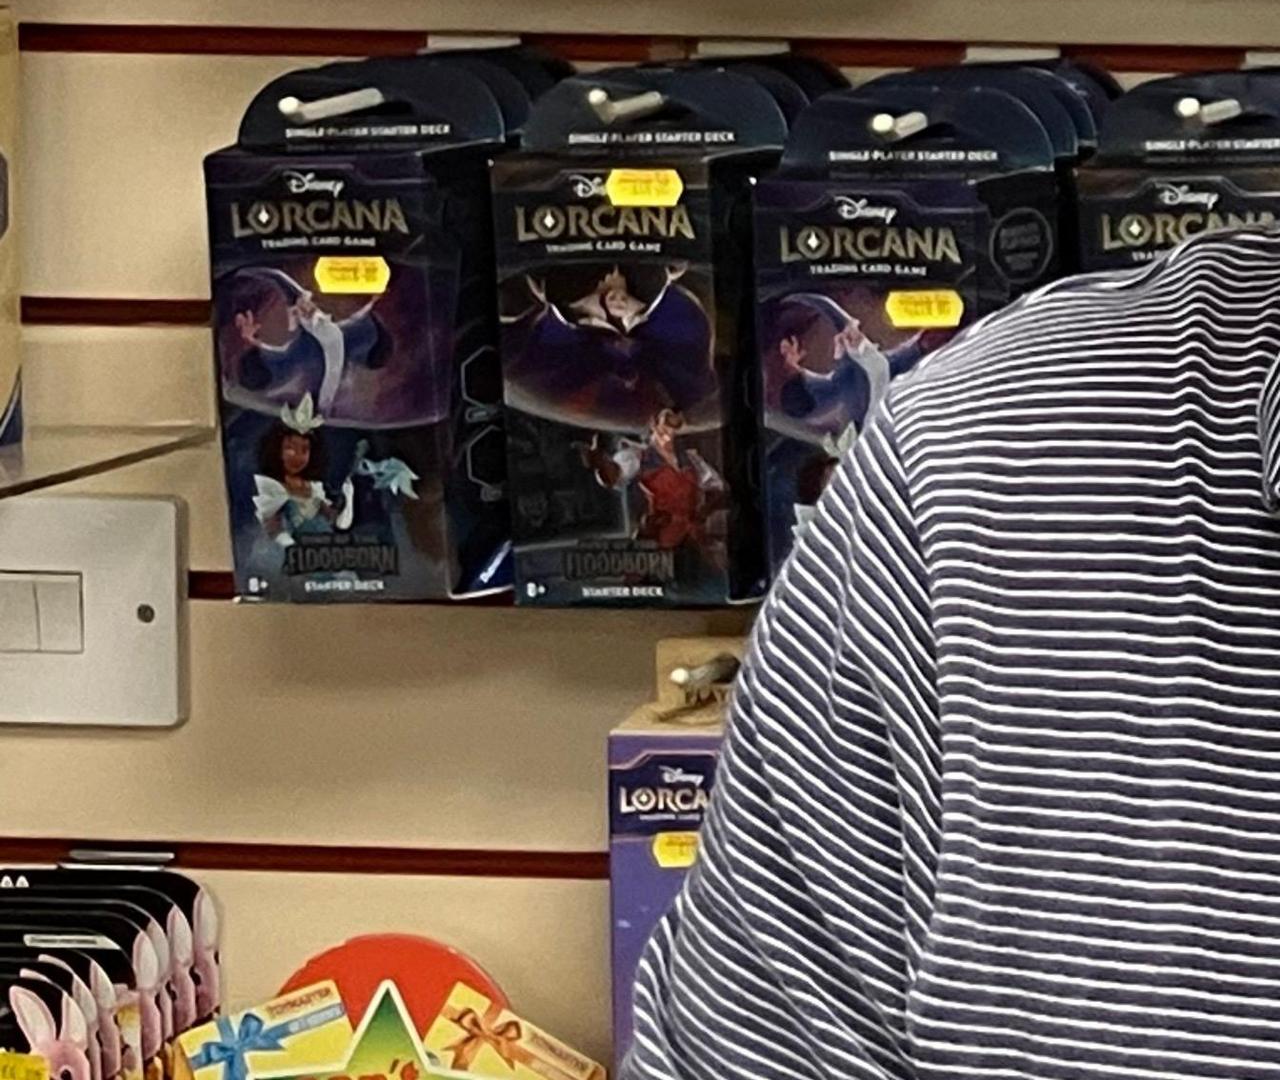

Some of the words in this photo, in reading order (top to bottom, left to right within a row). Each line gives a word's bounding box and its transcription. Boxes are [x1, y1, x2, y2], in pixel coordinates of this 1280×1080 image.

[285, 126, 367, 139] SINGLE-PLAYER
[370, 125, 418, 137] STARTER
[421, 123, 451, 135] DECK
[568, 131, 653, 144] SINGLE-PLAYER
[654, 132, 702, 143] STARTER
[704, 131, 735, 142] DECK
[1234, 139, 1280, 150] STARTER
[829, 150, 914, 162] SINGLE-PLAYER
[917, 151, 965, 161] STARTER
[968, 151, 998, 161] DECK
[282, 171, 345, 198] Disney
[1154, 182, 1219, 210] Disney
[834, 196, 898, 224] Disney
[231, 200, 409, 238] LORCANA
[516, 204, 695, 241] LORCANA
[262, 237, 308, 250] TRADING
[311, 237, 341, 248] CARD
[344, 237, 376, 248] GAME
[546, 243, 592, 253] TRADING
[595, 242, 626, 252] CARD
[629, 243, 661, 253] GAME
[780, 225, 962, 264] LORCANA
[810, 264, 858, 275] TRADING
[861, 263, 891, 273] CARD
[895, 265, 926, 276] GAME
[632, 587, 663, 597] DECK
[659, 765, 704, 786] Disney
